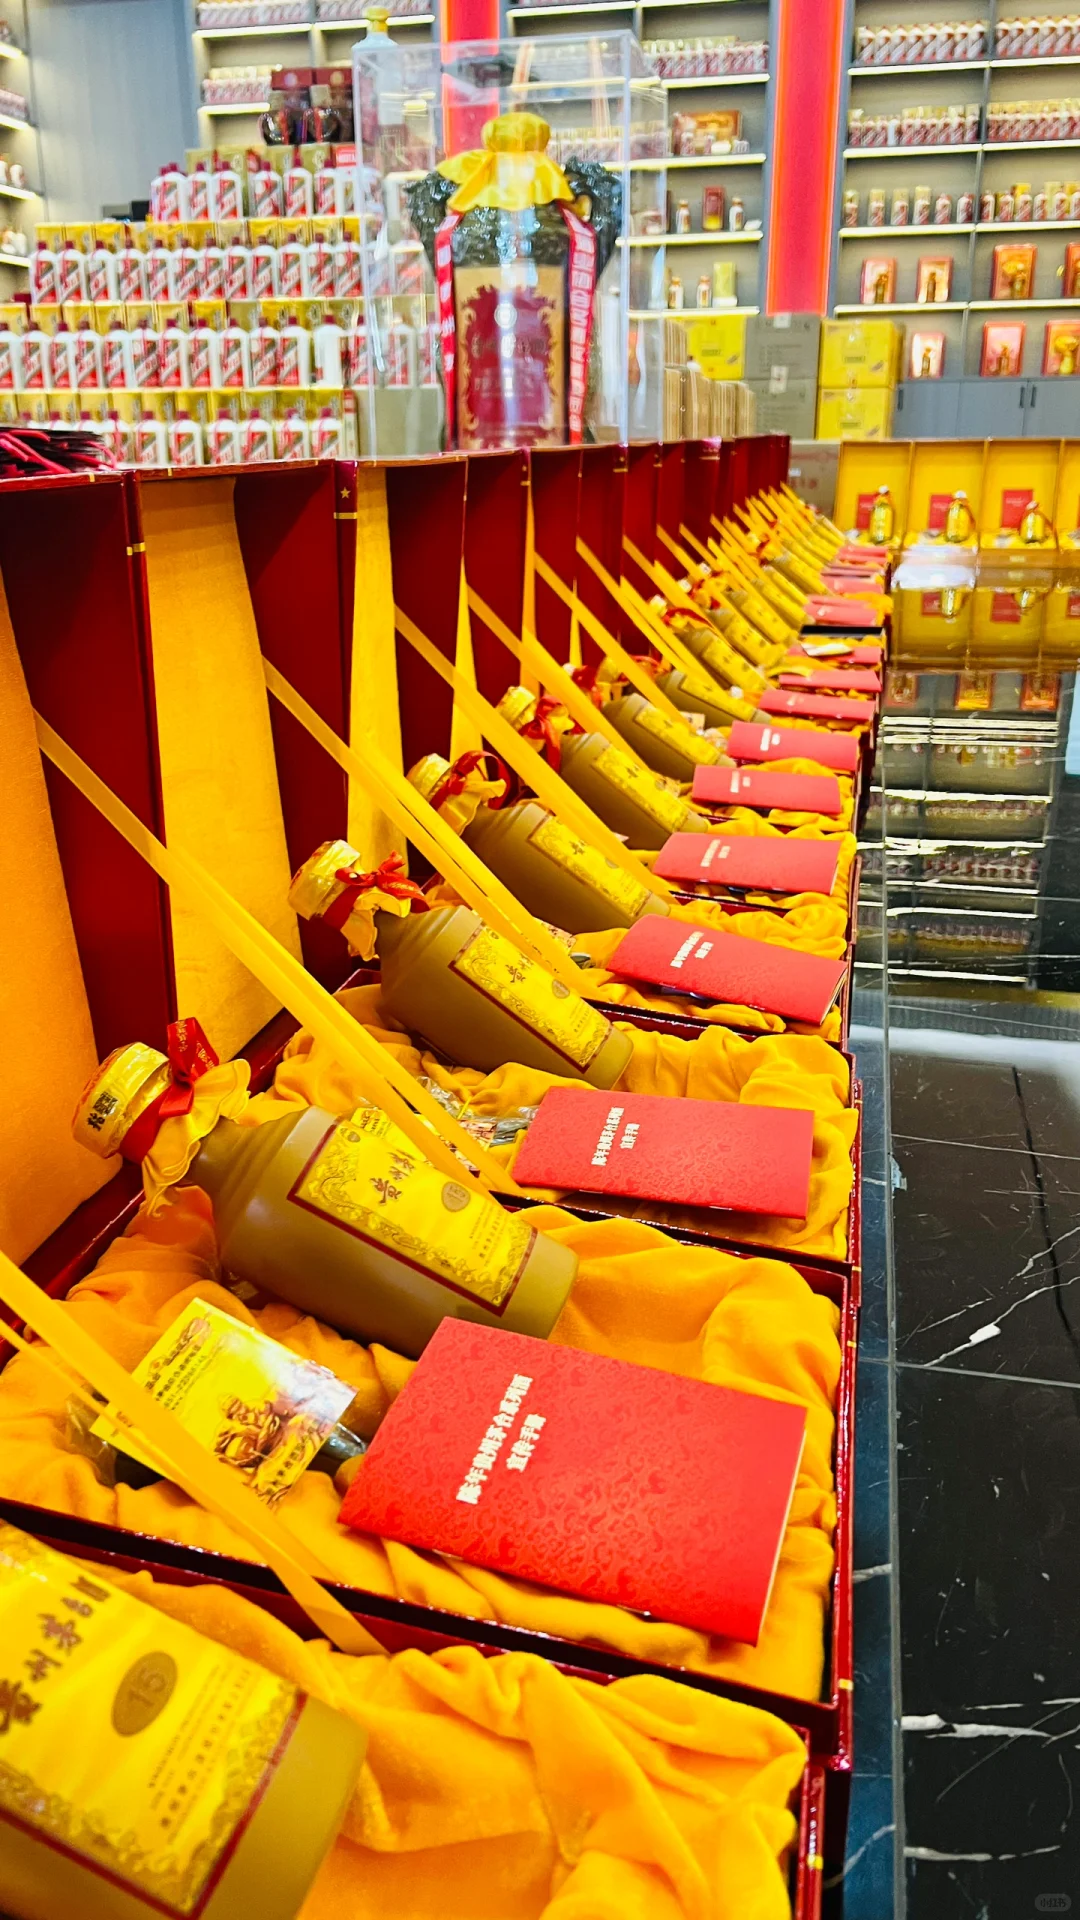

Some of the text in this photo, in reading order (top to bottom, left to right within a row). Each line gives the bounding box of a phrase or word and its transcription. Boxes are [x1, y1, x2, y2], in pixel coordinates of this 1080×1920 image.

[456, 1373, 534, 1505] 陈年贵州茅台系列酒
[506, 1413, 547, 1473] 宣传手册
[127, 1663, 168, 1709] 15
